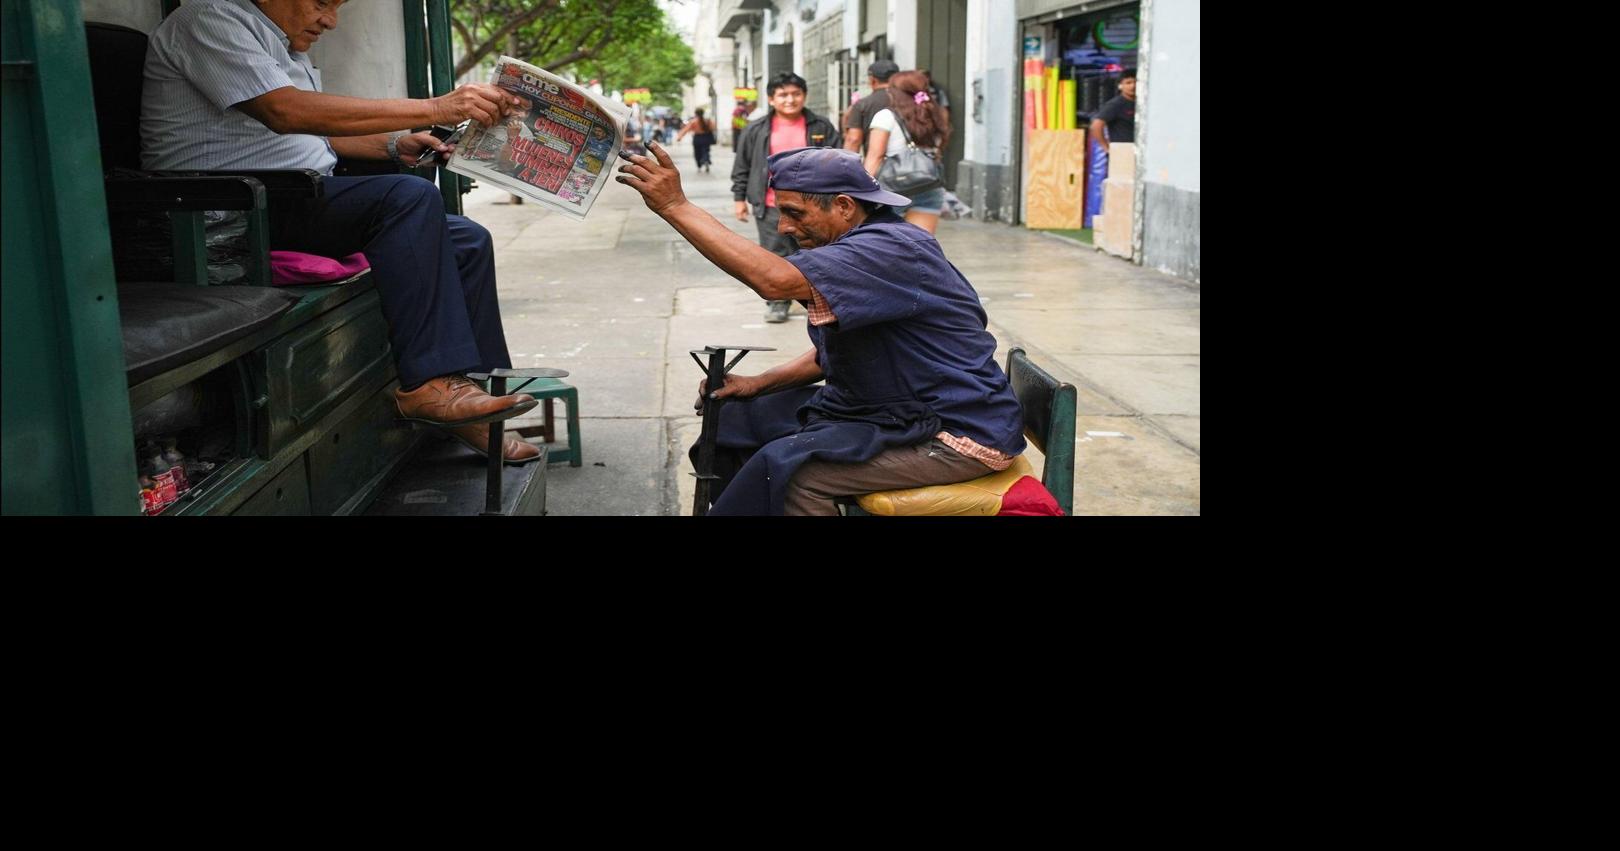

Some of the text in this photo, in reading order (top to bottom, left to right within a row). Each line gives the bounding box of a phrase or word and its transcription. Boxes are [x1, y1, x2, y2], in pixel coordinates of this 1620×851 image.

[520, 83, 541, 97] HOY
[541, 91, 584, 113] CUPONES
[549, 104, 592, 127] PRESIDENTE
[534, 116, 585, 146] CHINOS
[511, 134, 573, 169] MUJERES
[511, 149, 569, 182] TUMBAN
[517, 167, 530, 182] A
